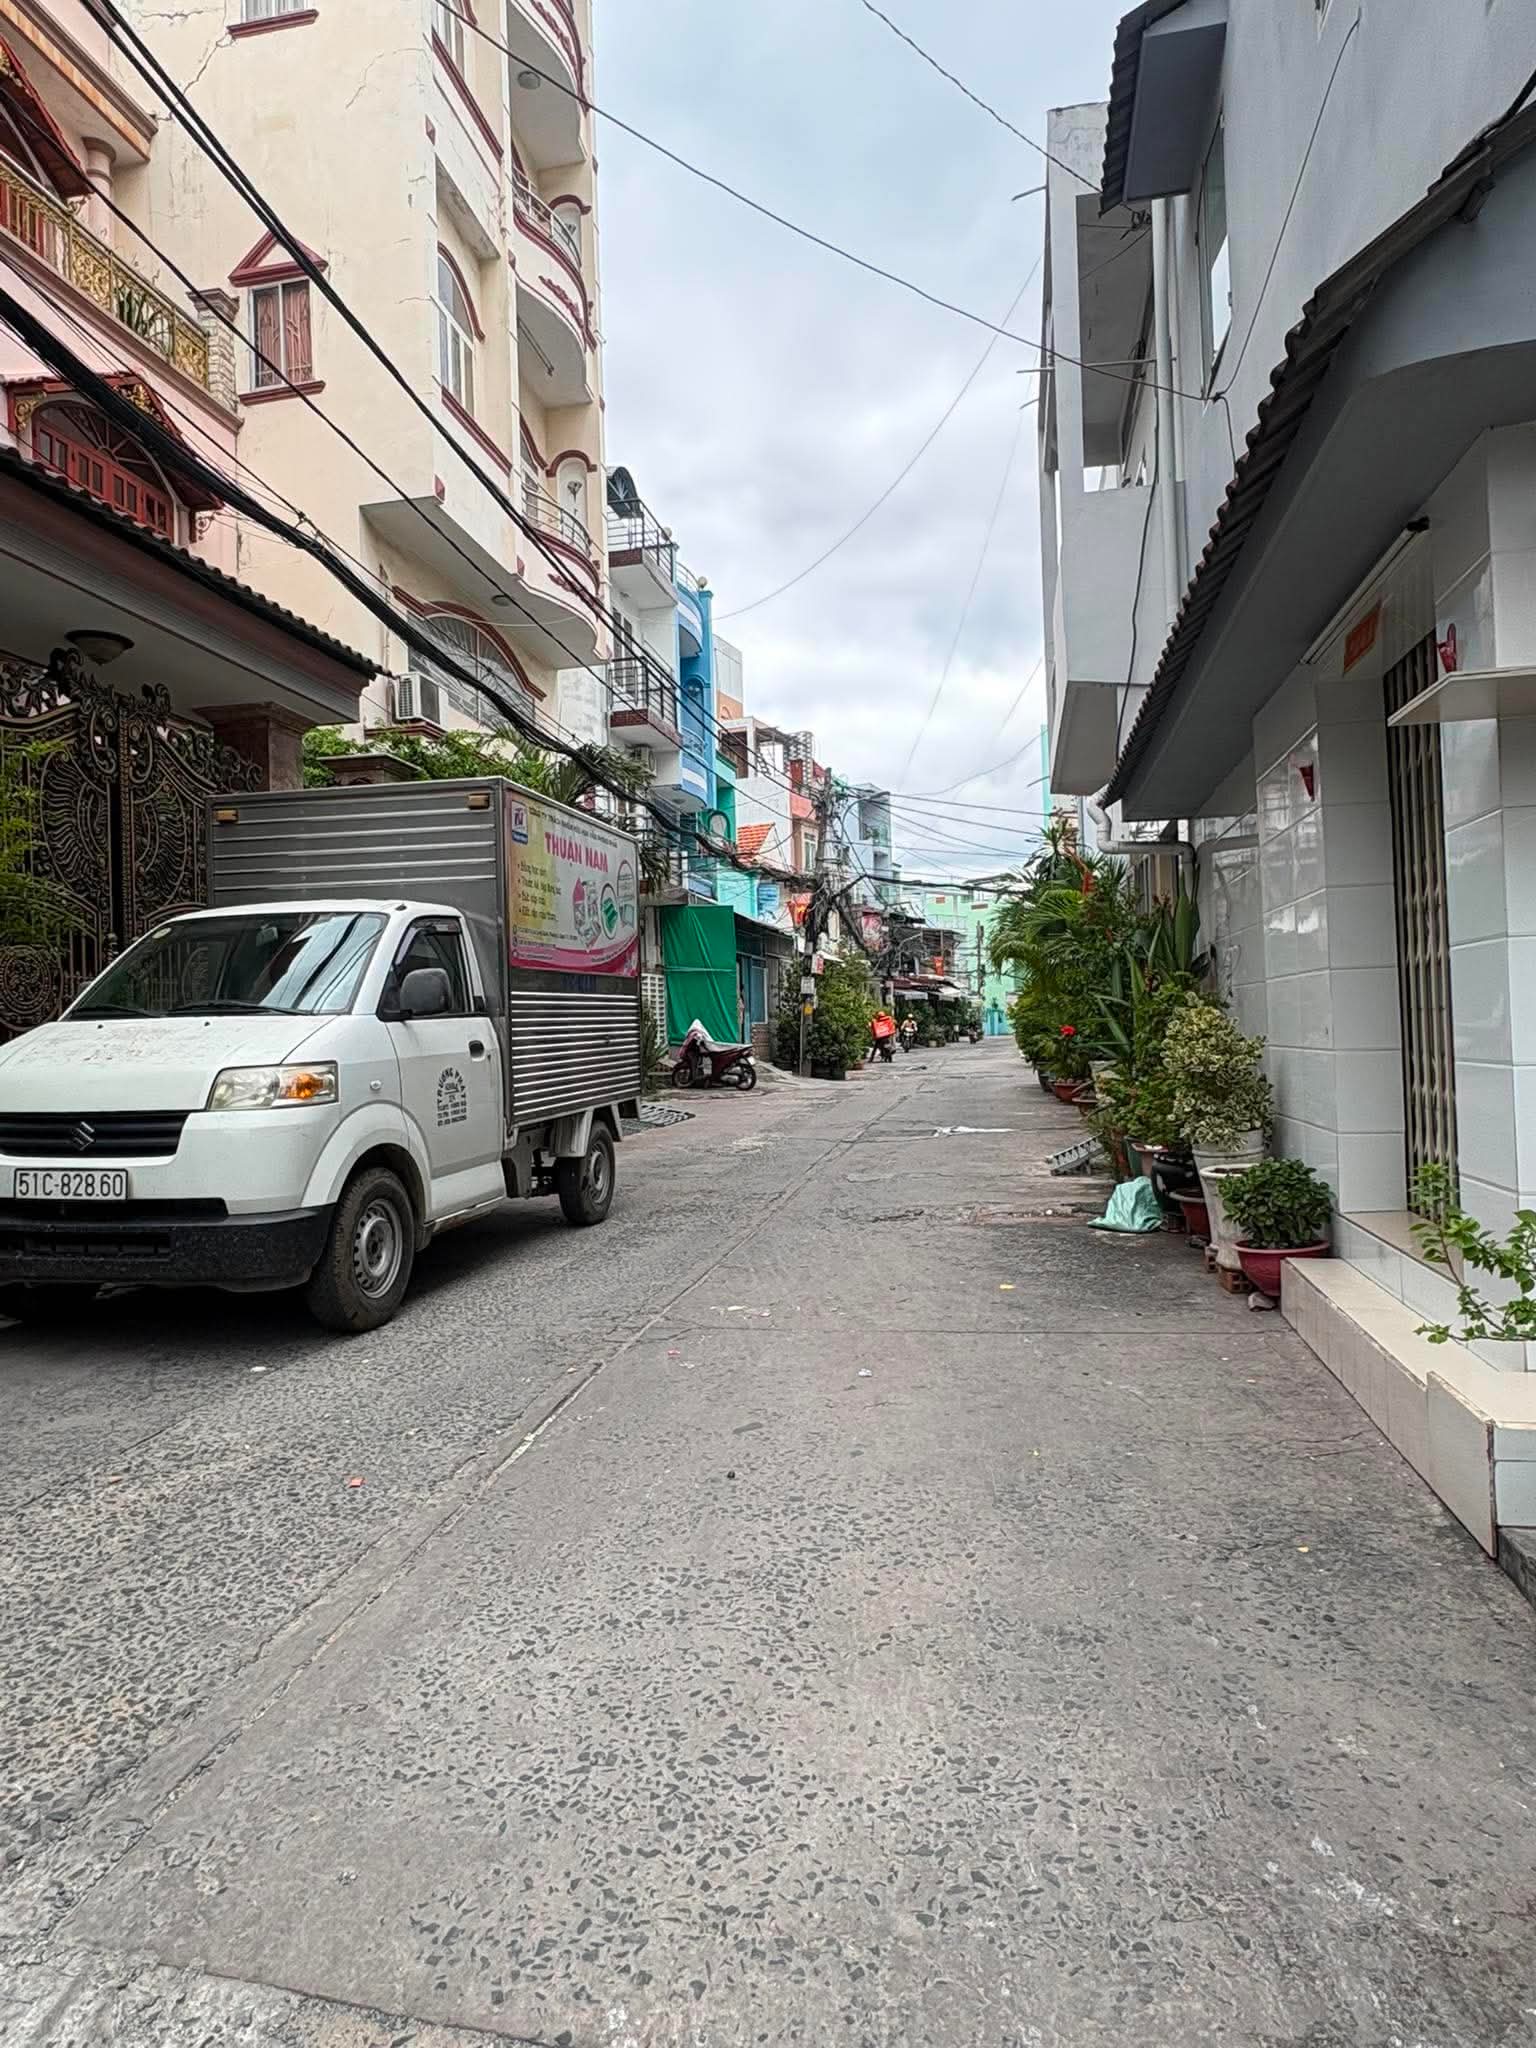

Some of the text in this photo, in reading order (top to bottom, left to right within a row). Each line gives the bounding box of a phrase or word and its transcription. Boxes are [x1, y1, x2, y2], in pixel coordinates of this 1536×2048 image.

[544, 832, 582, 867] THUẬN
[585, 846, 609, 873] NAM
[18, 1172, 124, 1198] 51C-828.60
